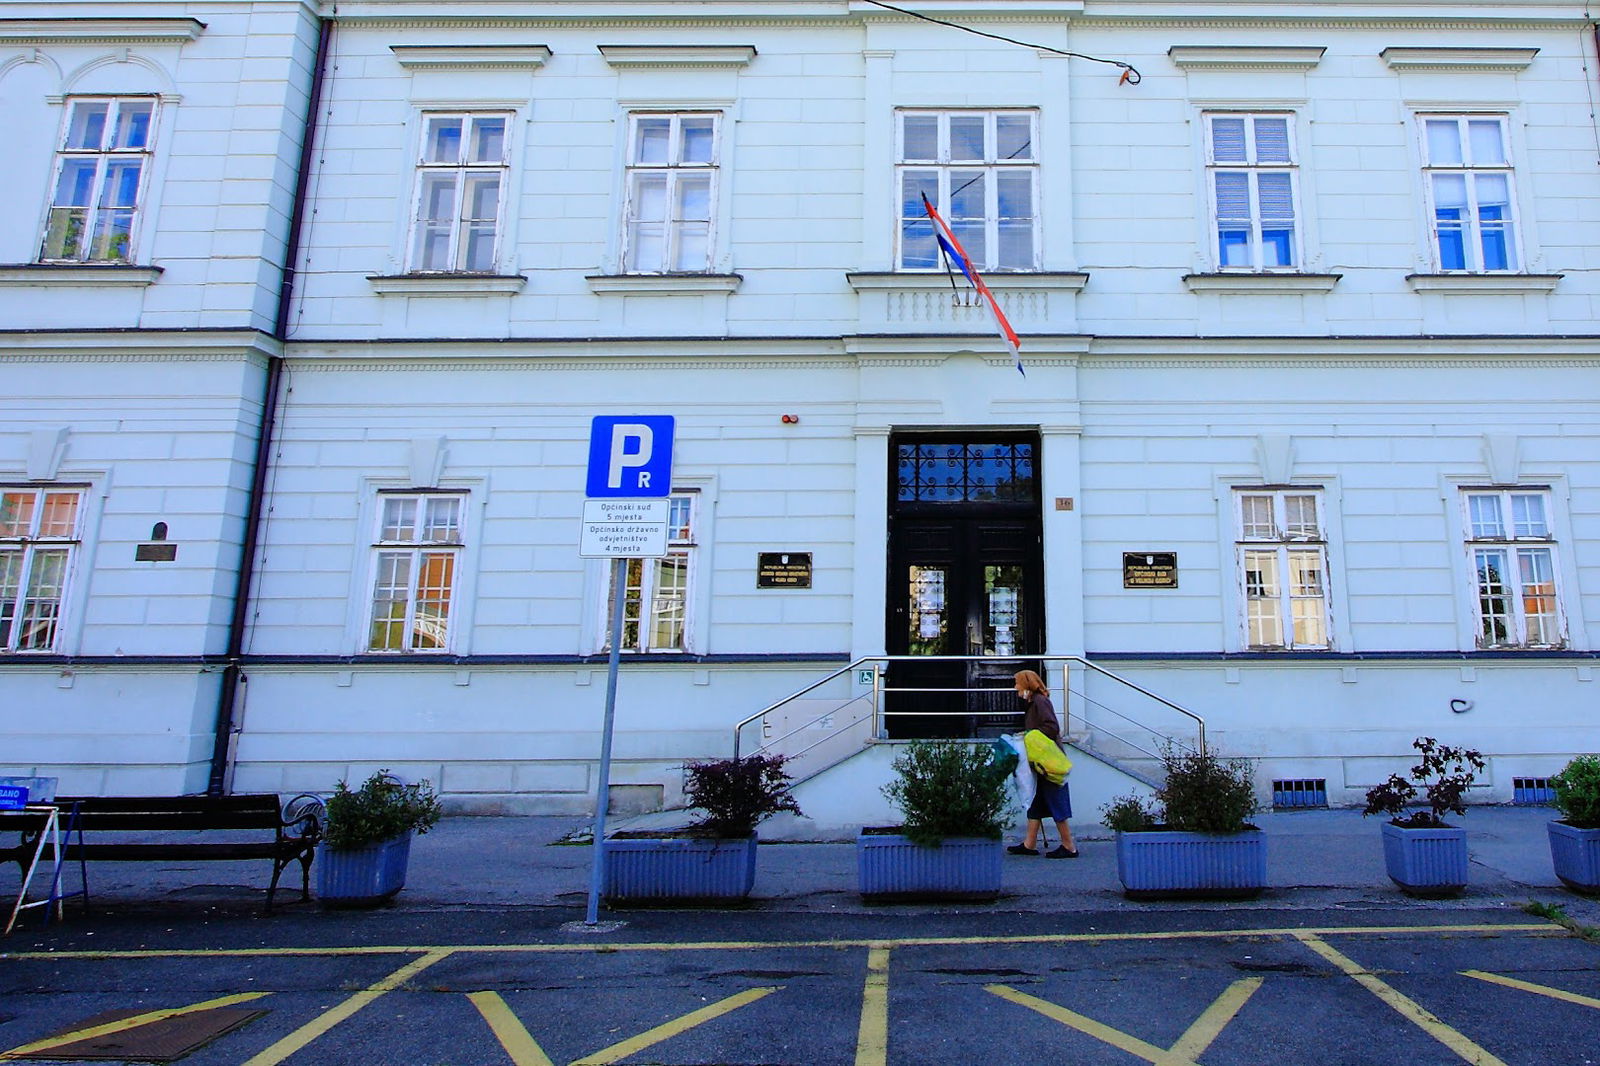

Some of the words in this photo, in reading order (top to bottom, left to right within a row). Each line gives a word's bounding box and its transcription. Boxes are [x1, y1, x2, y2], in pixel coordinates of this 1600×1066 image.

[608, 424, 653, 488] P
[638, 471, 651, 488] R
[601, 503, 634, 511] Općinski
[637, 503, 651, 511] sud
[614, 514, 642, 522] mjesta
[590, 526, 624, 534] Općinsko
[599, 535, 648, 543] odvjetništvo
[613, 545, 641, 553] mjesta
